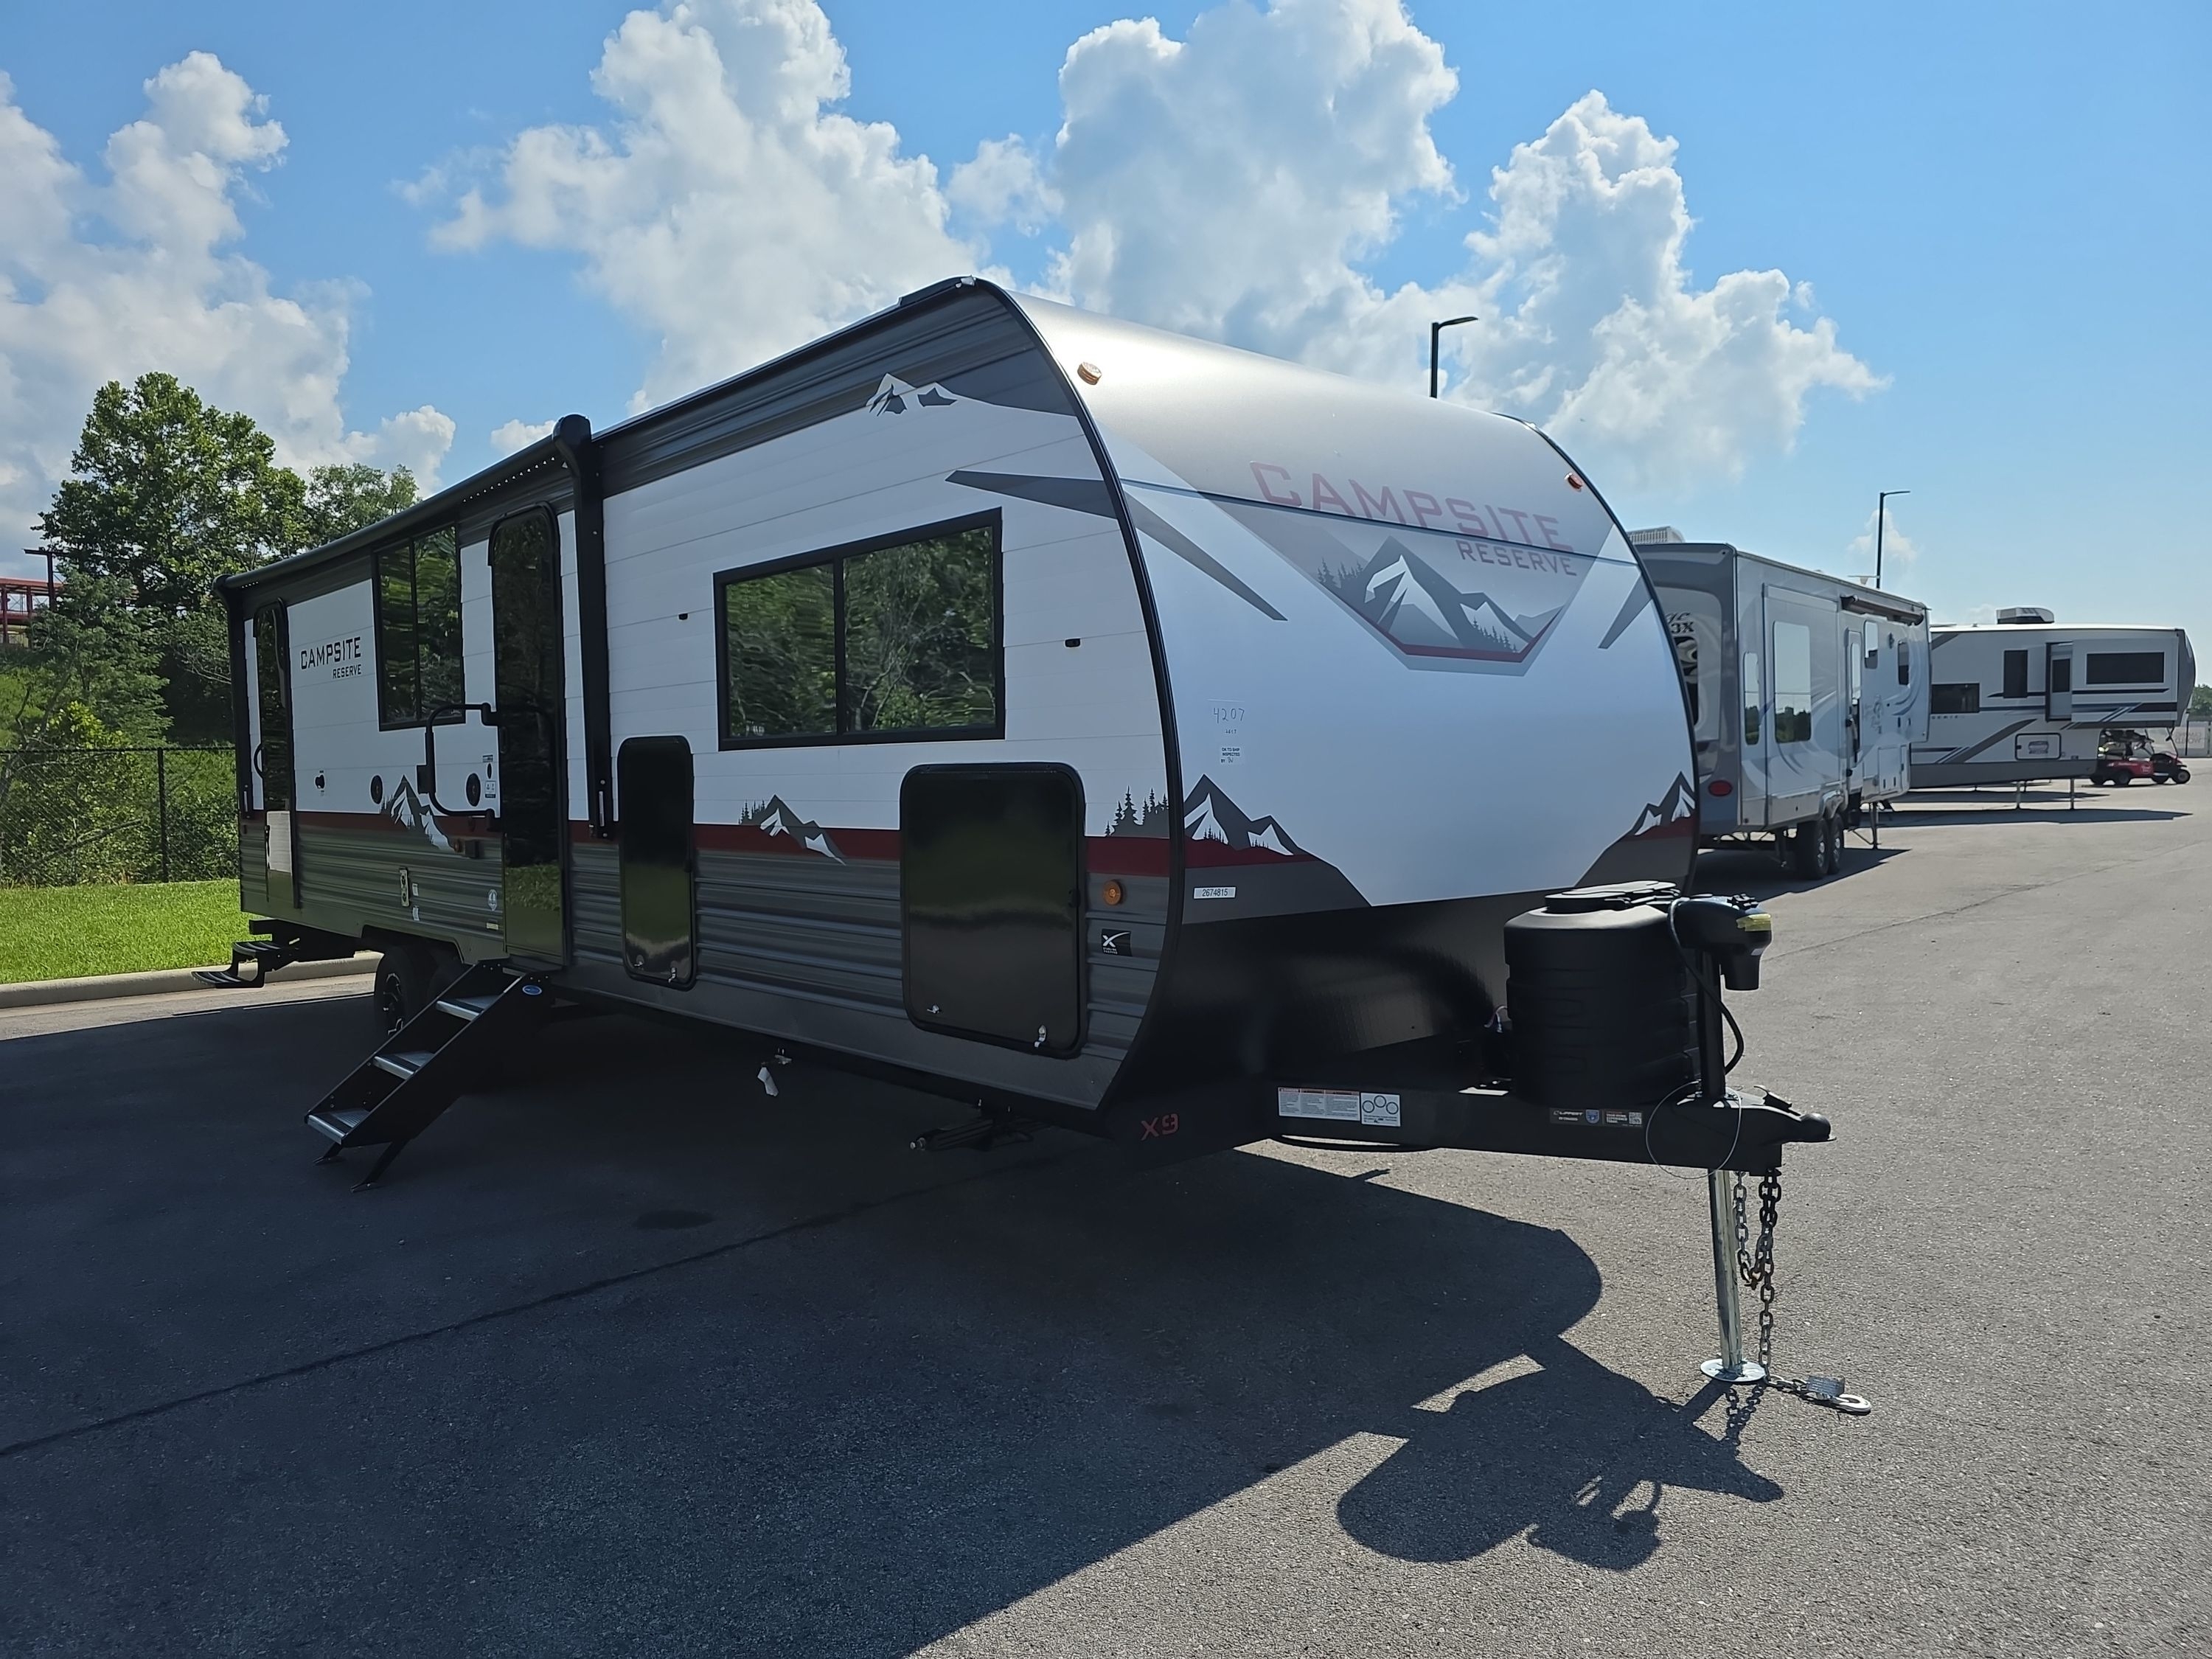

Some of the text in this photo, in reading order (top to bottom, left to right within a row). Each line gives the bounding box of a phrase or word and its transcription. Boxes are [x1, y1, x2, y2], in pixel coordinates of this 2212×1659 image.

[1249, 460, 1574, 554] CAMPSITE
[1455, 540, 1577, 577] RESERVE
[301, 636, 361, 669] CAMPSITE
[333, 664, 361, 678] RESERVE
[1213, 707, 1245, 723] 4207
[1201, 888, 1228, 898] 2674815
